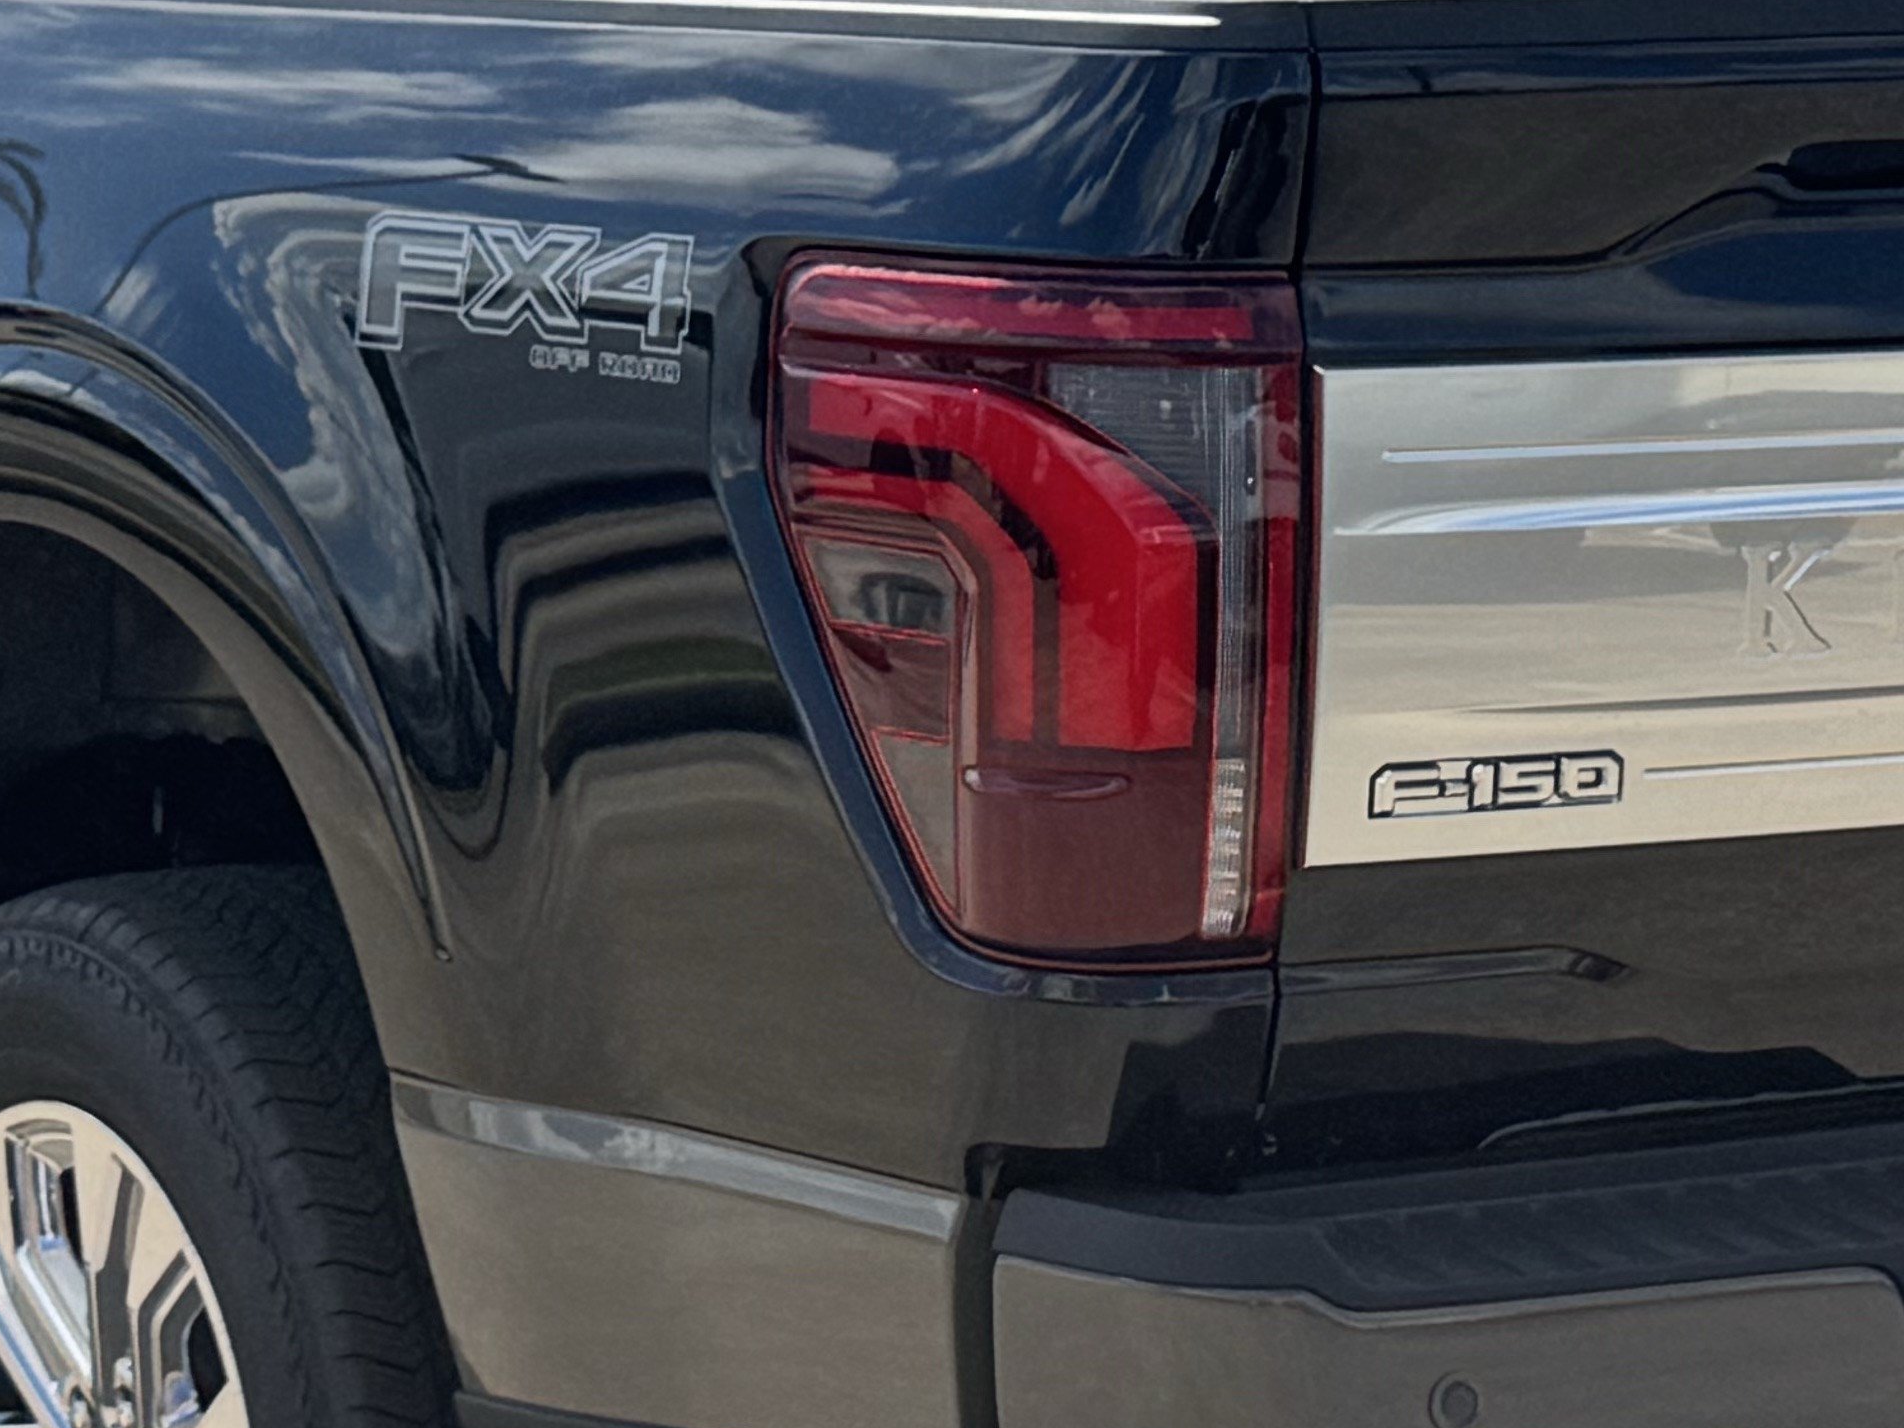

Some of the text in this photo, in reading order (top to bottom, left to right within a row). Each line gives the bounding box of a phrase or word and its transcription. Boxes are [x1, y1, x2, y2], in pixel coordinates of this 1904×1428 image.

[355, 209, 694, 355] FX4
[529, 344, 681, 384] OFF ROAD
[1368, 748, 1625, 819] F-150
